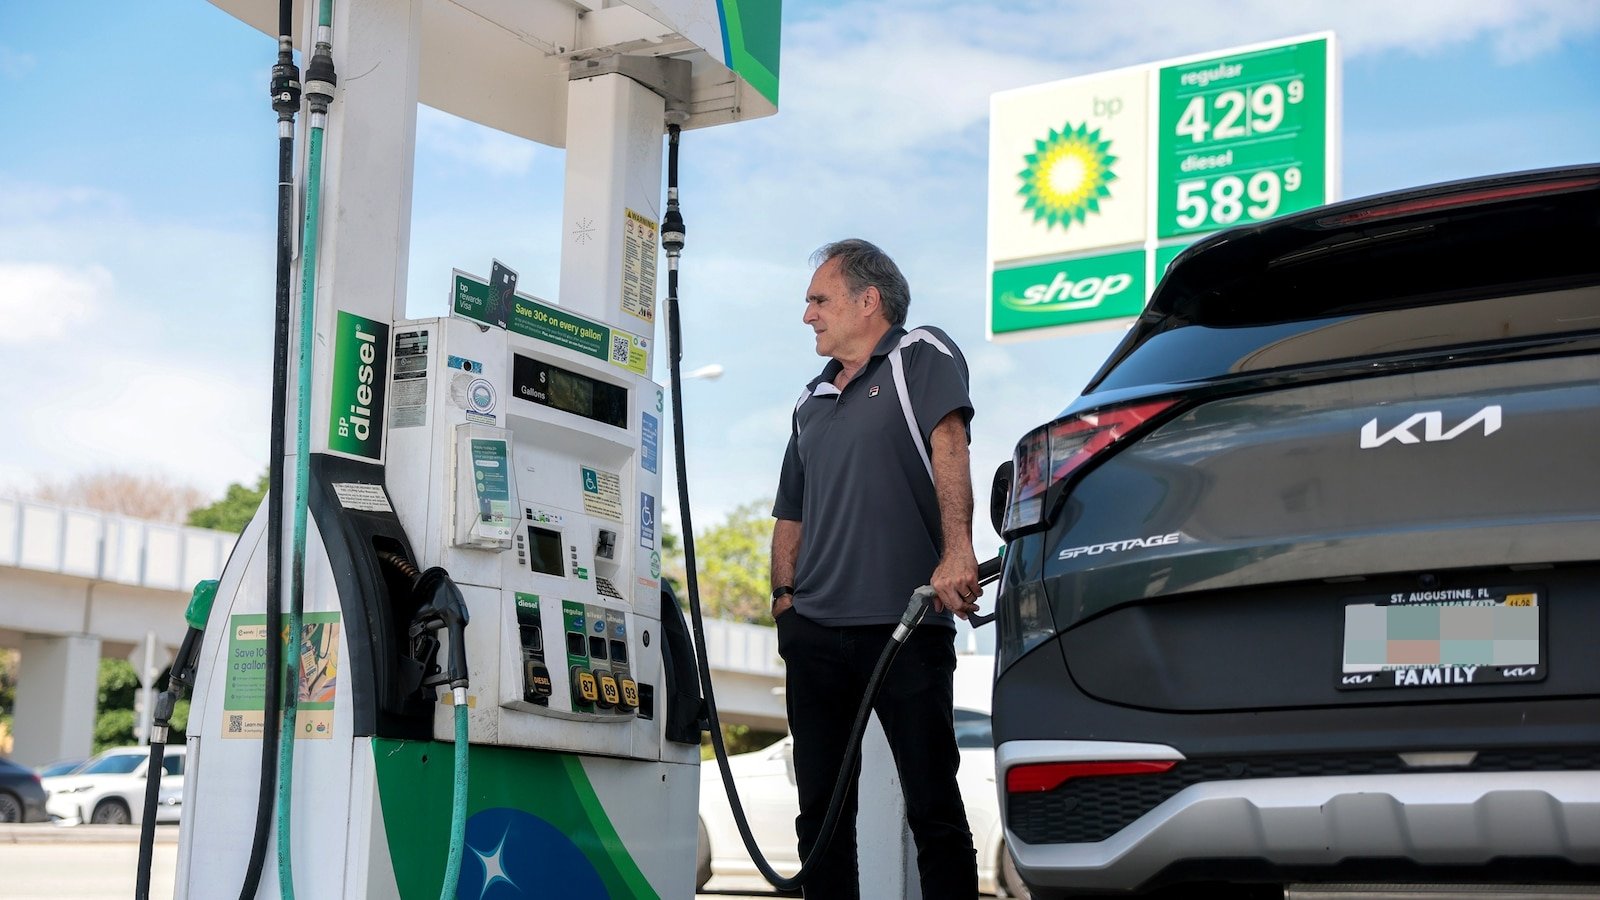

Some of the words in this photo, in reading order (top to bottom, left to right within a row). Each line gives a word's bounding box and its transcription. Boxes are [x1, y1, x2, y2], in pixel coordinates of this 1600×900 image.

[1181, 63, 1243, 87] regular
[1093, 96, 1123, 119] bp
[1181, 149, 1234, 172] diesel
[460, 281, 469, 293] bp
[1023, 272, 1133, 308] shop
[460, 292, 482, 306] rewards
[460, 300, 472, 311] Visa
[515, 303, 533, 318] Save
[533, 309, 548, 322] 30¢
[549, 317, 559, 328] on
[559, 320, 580, 335] every
[539, 371, 546, 383] $
[520, 384, 546, 400] Gallons
[655, 389, 664, 413] 3
[338, 416, 349, 438] BP
[1360, 405, 1502, 449] KIA
[1058, 532, 1180, 560] SPORTAGE
[1390, 593, 1406, 604] ST.
[1409, 588, 1475, 602] AUGUSTINE,
[1477, 588, 1490, 598] FL
[518, 600, 539, 609] diesel
[563, 607, 584, 616] regular
[586, 611, 603, 619] silver
[235, 648, 255, 658] Save
[533, 676, 550, 685] DIESEL
[1394, 666, 1478, 686] FAMILY
[582, 680, 593, 693] 87
[604, 683, 616, 697] 89
[625, 686, 637, 699] 93
